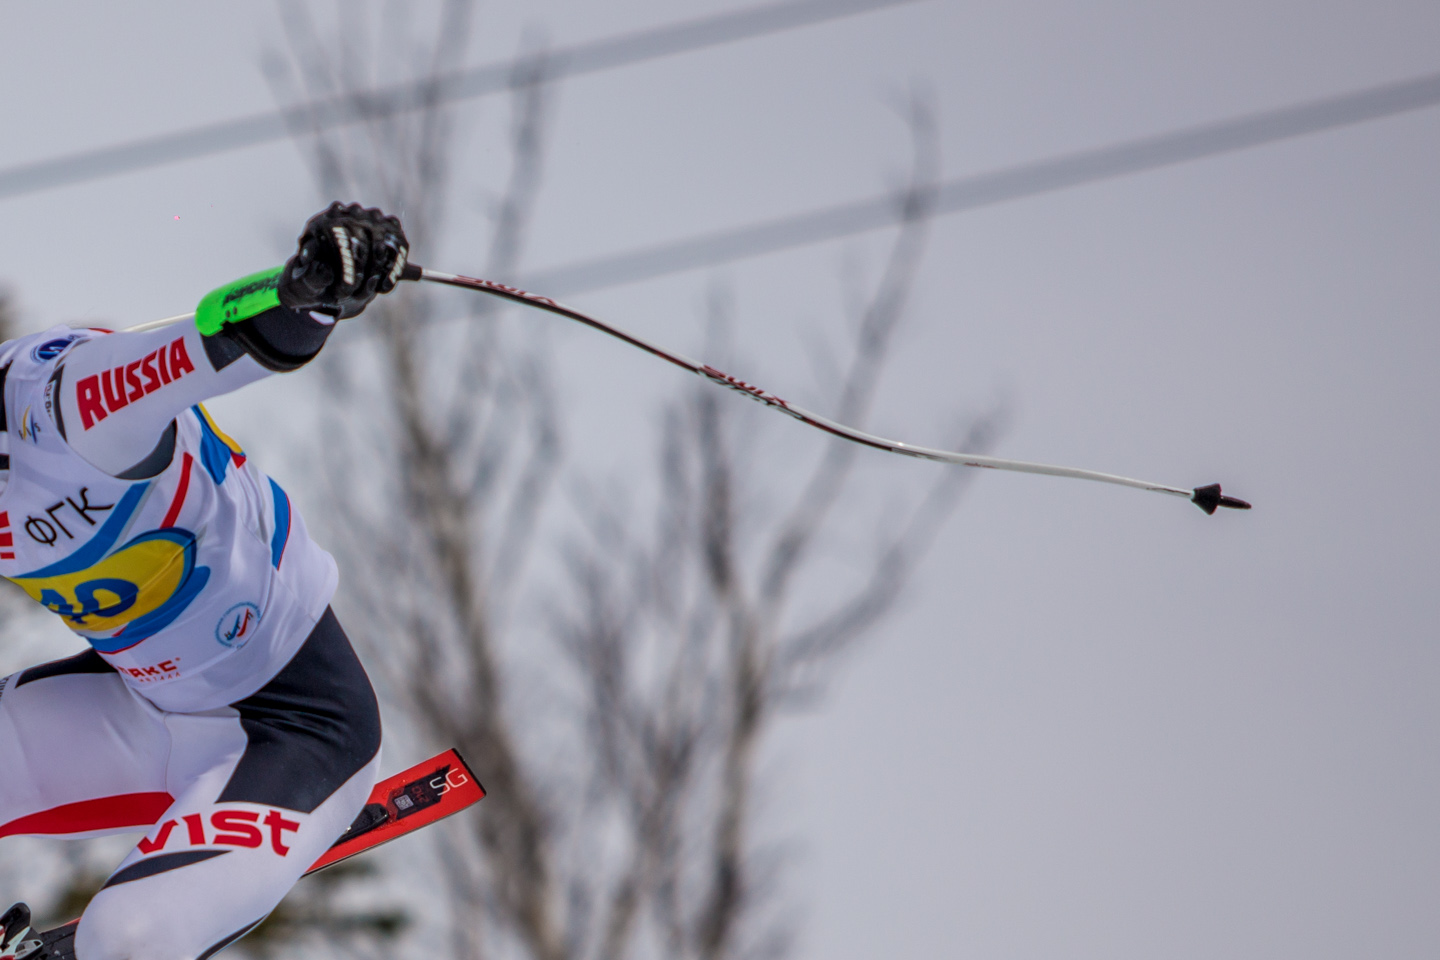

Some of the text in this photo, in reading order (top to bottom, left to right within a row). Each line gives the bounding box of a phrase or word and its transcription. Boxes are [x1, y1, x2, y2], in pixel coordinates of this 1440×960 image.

[75, 335, 195, 432] RUSSIA
[24, 487, 116, 547] ФГК
[429, 767, 469, 796] SG
